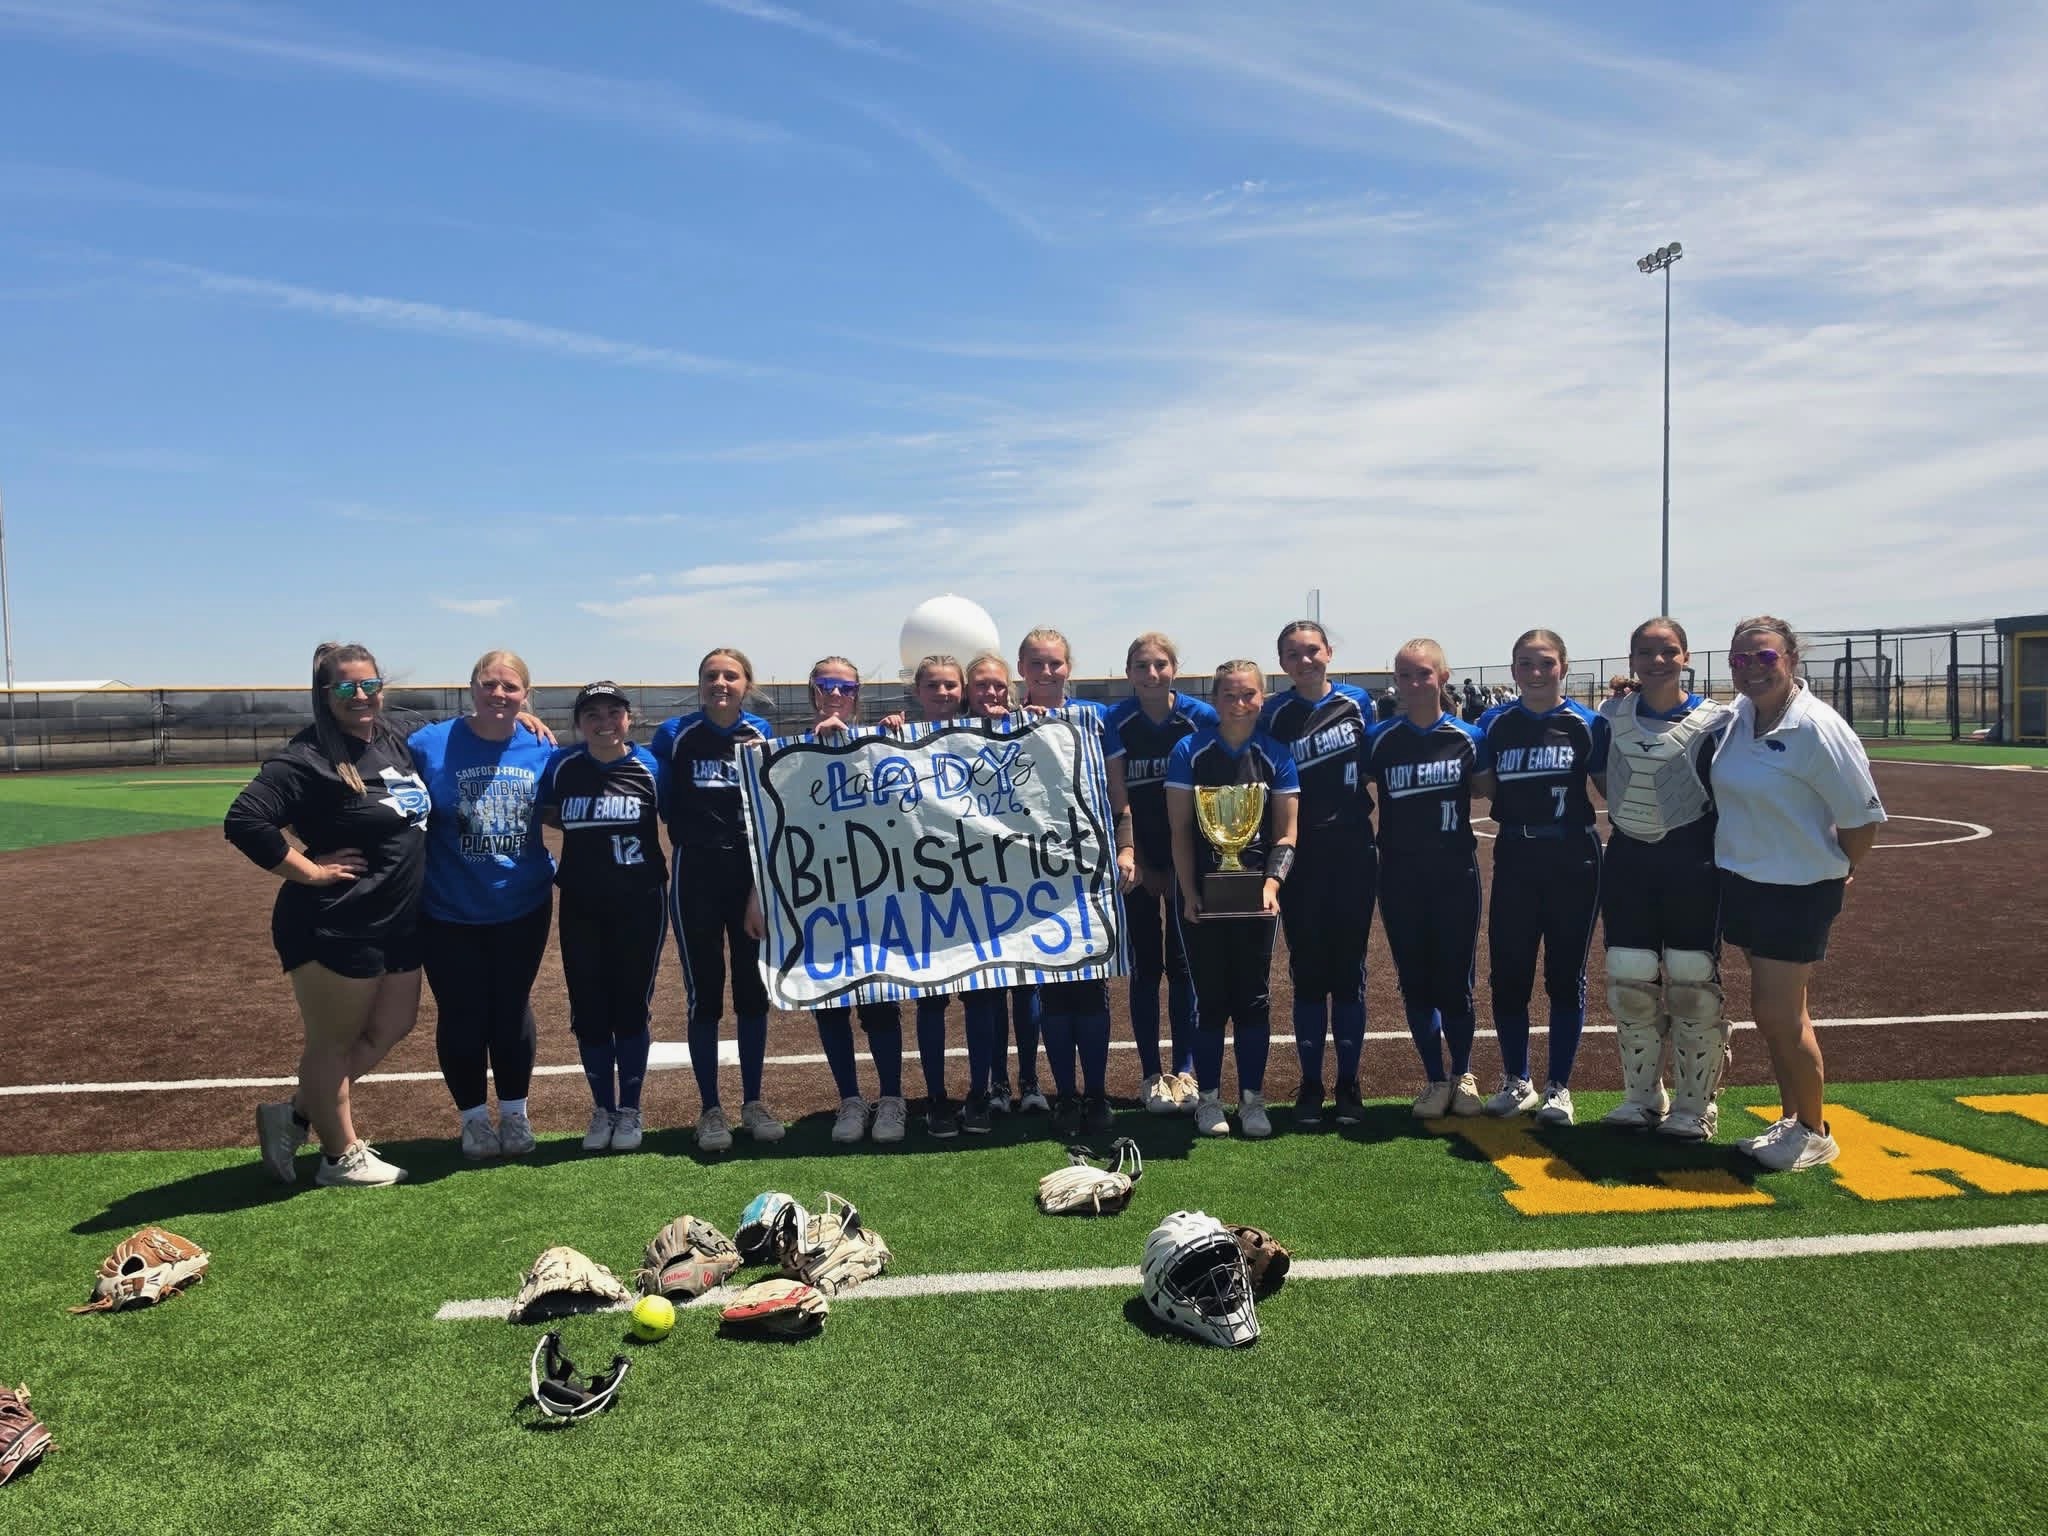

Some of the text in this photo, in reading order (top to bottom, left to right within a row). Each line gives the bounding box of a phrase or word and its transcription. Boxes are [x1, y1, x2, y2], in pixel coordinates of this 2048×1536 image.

[1314, 722, 1356, 756] EAGLES
[1127, 759, 1149, 779] ADY
[1385, 758, 1461, 791] LADY EAGLES
[1496, 745, 1575, 773] LADY EAGLES
[459, 780, 537, 797] SOFTBALL
[826, 742, 1021, 811] LADY
[1345, 761, 1358, 793] 4
[561, 795, 641, 820] LADY EAGLES
[959, 788, 1024, 818] 2026
[1551, 786, 1569, 817] 7
[610, 834, 645, 865] 12
[784, 806, 1095, 909] Bi-District
[803, 874, 1095, 981] CHAMPS!
